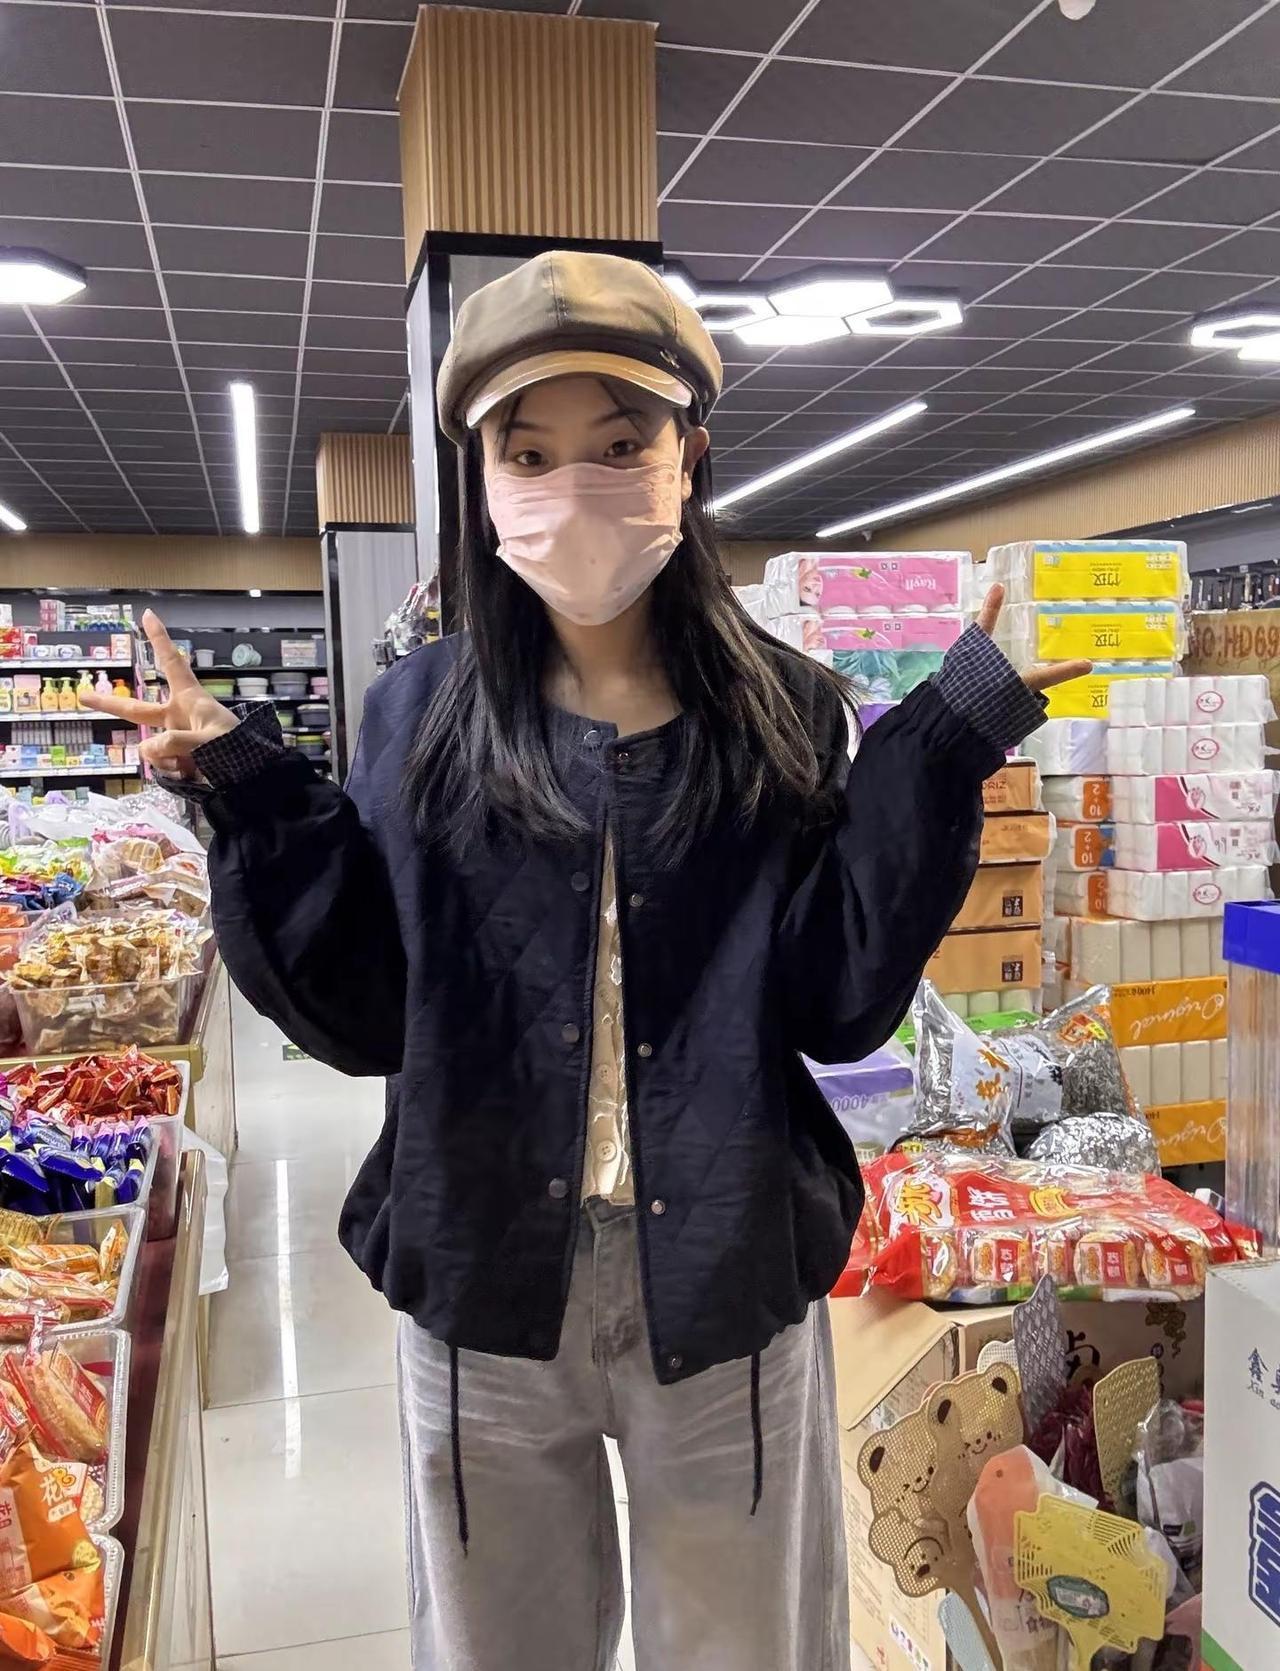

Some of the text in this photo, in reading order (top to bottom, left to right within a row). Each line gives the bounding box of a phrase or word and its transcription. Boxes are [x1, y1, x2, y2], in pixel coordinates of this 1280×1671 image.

[1089, 804, 1102, 816] 10
[1081, 852, 1093, 864] 10
[1129, 993, 1225, 1041] Original
